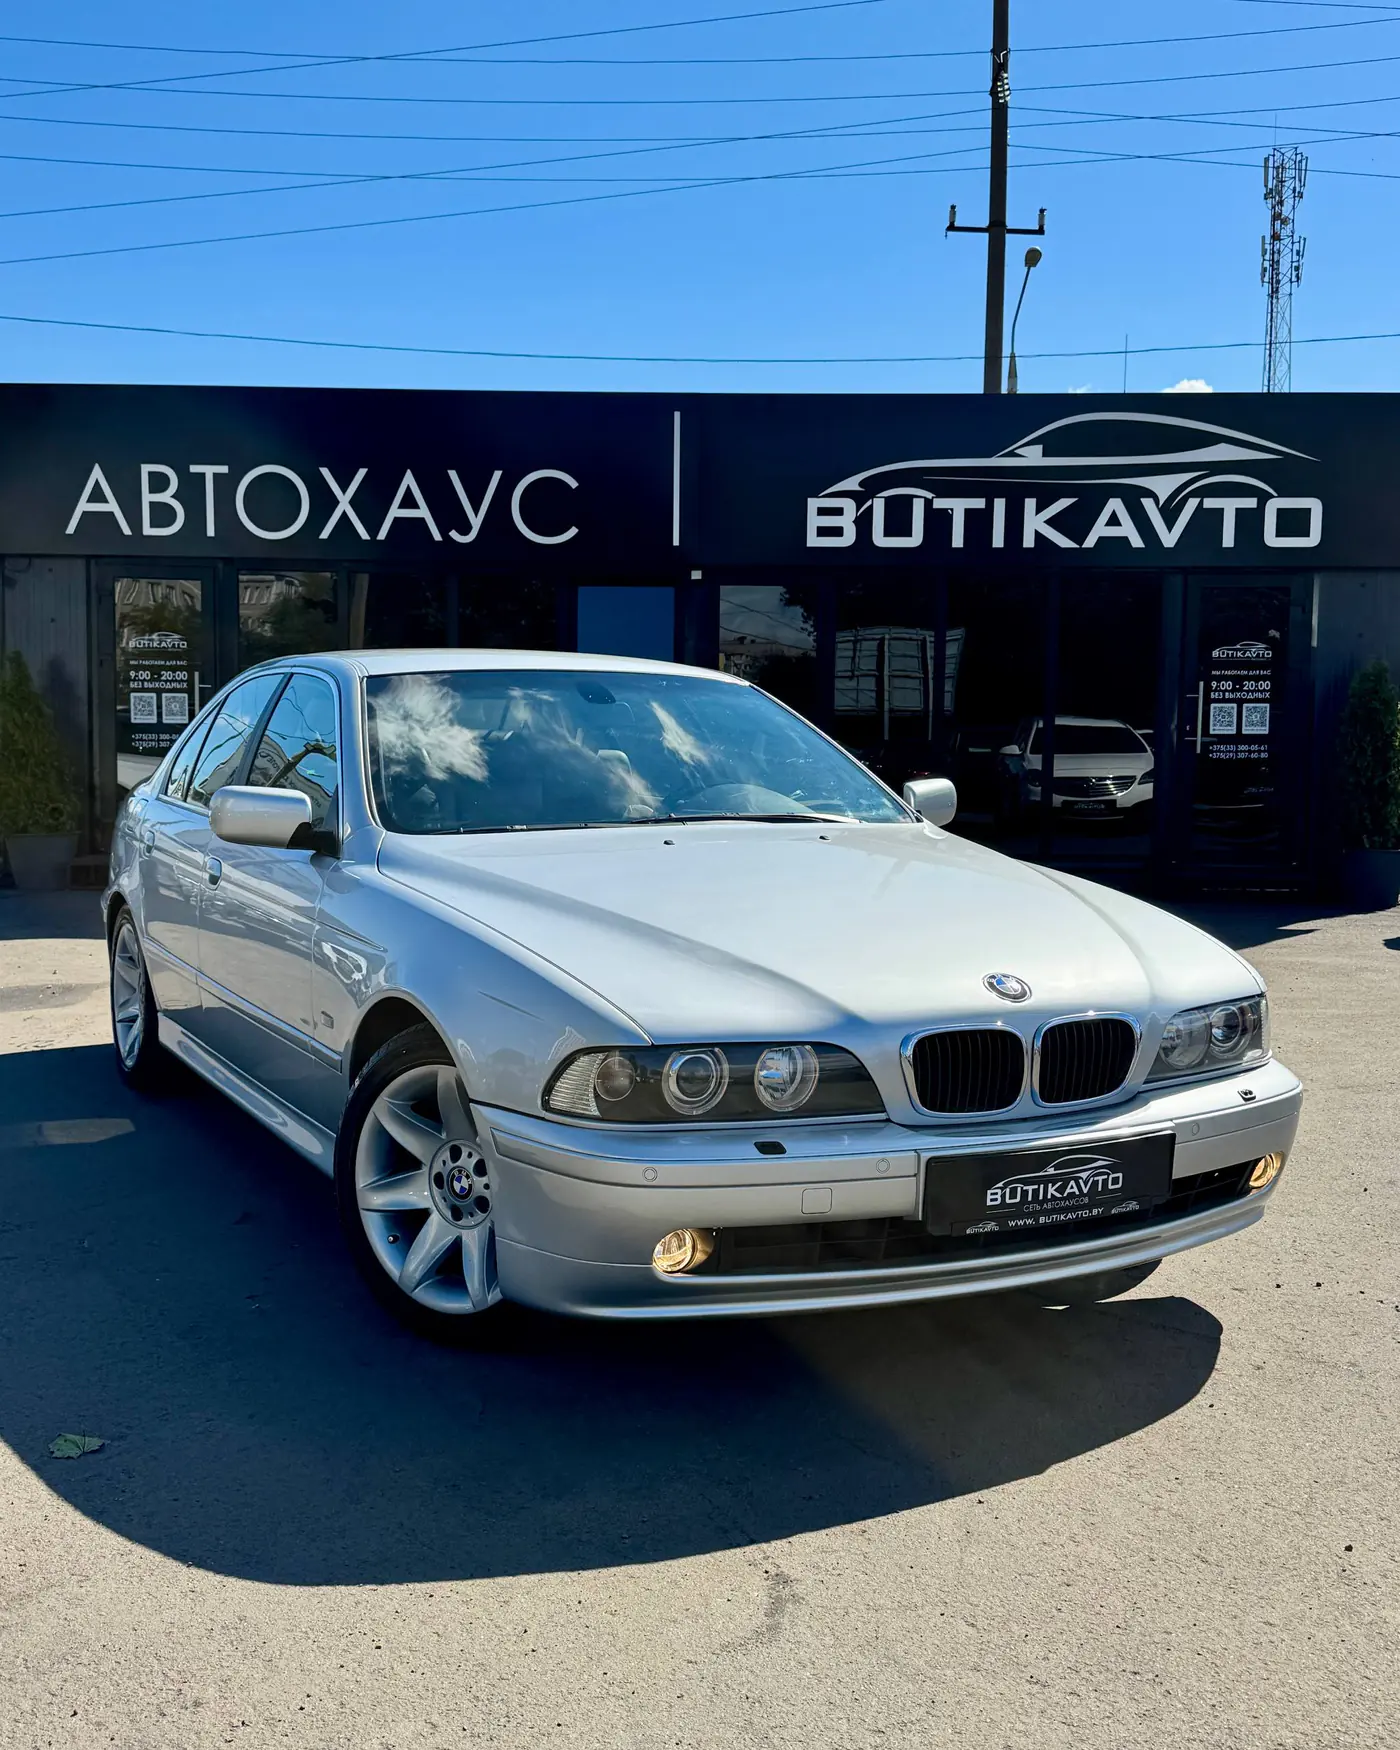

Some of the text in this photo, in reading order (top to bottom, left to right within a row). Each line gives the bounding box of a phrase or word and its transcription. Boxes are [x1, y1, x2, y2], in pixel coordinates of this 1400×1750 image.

[65, 463, 579, 544] АВТОХАУС
[806, 497, 1323, 548] BUTIKAVTO
[129, 640, 187, 648] BUTIKAVTO
[130, 671, 151, 680] 9:00
[160, 671, 188, 681] 20:00
[143, 681, 188, 689] ВЫХОДНЫХ
[1211, 681, 1232, 690] 9:00
[1243, 681, 1271, 690] 20:00
[986, 1173, 1123, 1206] BUTIKAVTO
[1023, 1196, 1089, 1212] СЕТЬ АВТОХАУСОВ
[1039, 1207, 1104, 1224] BUTIKAVTO.BY
